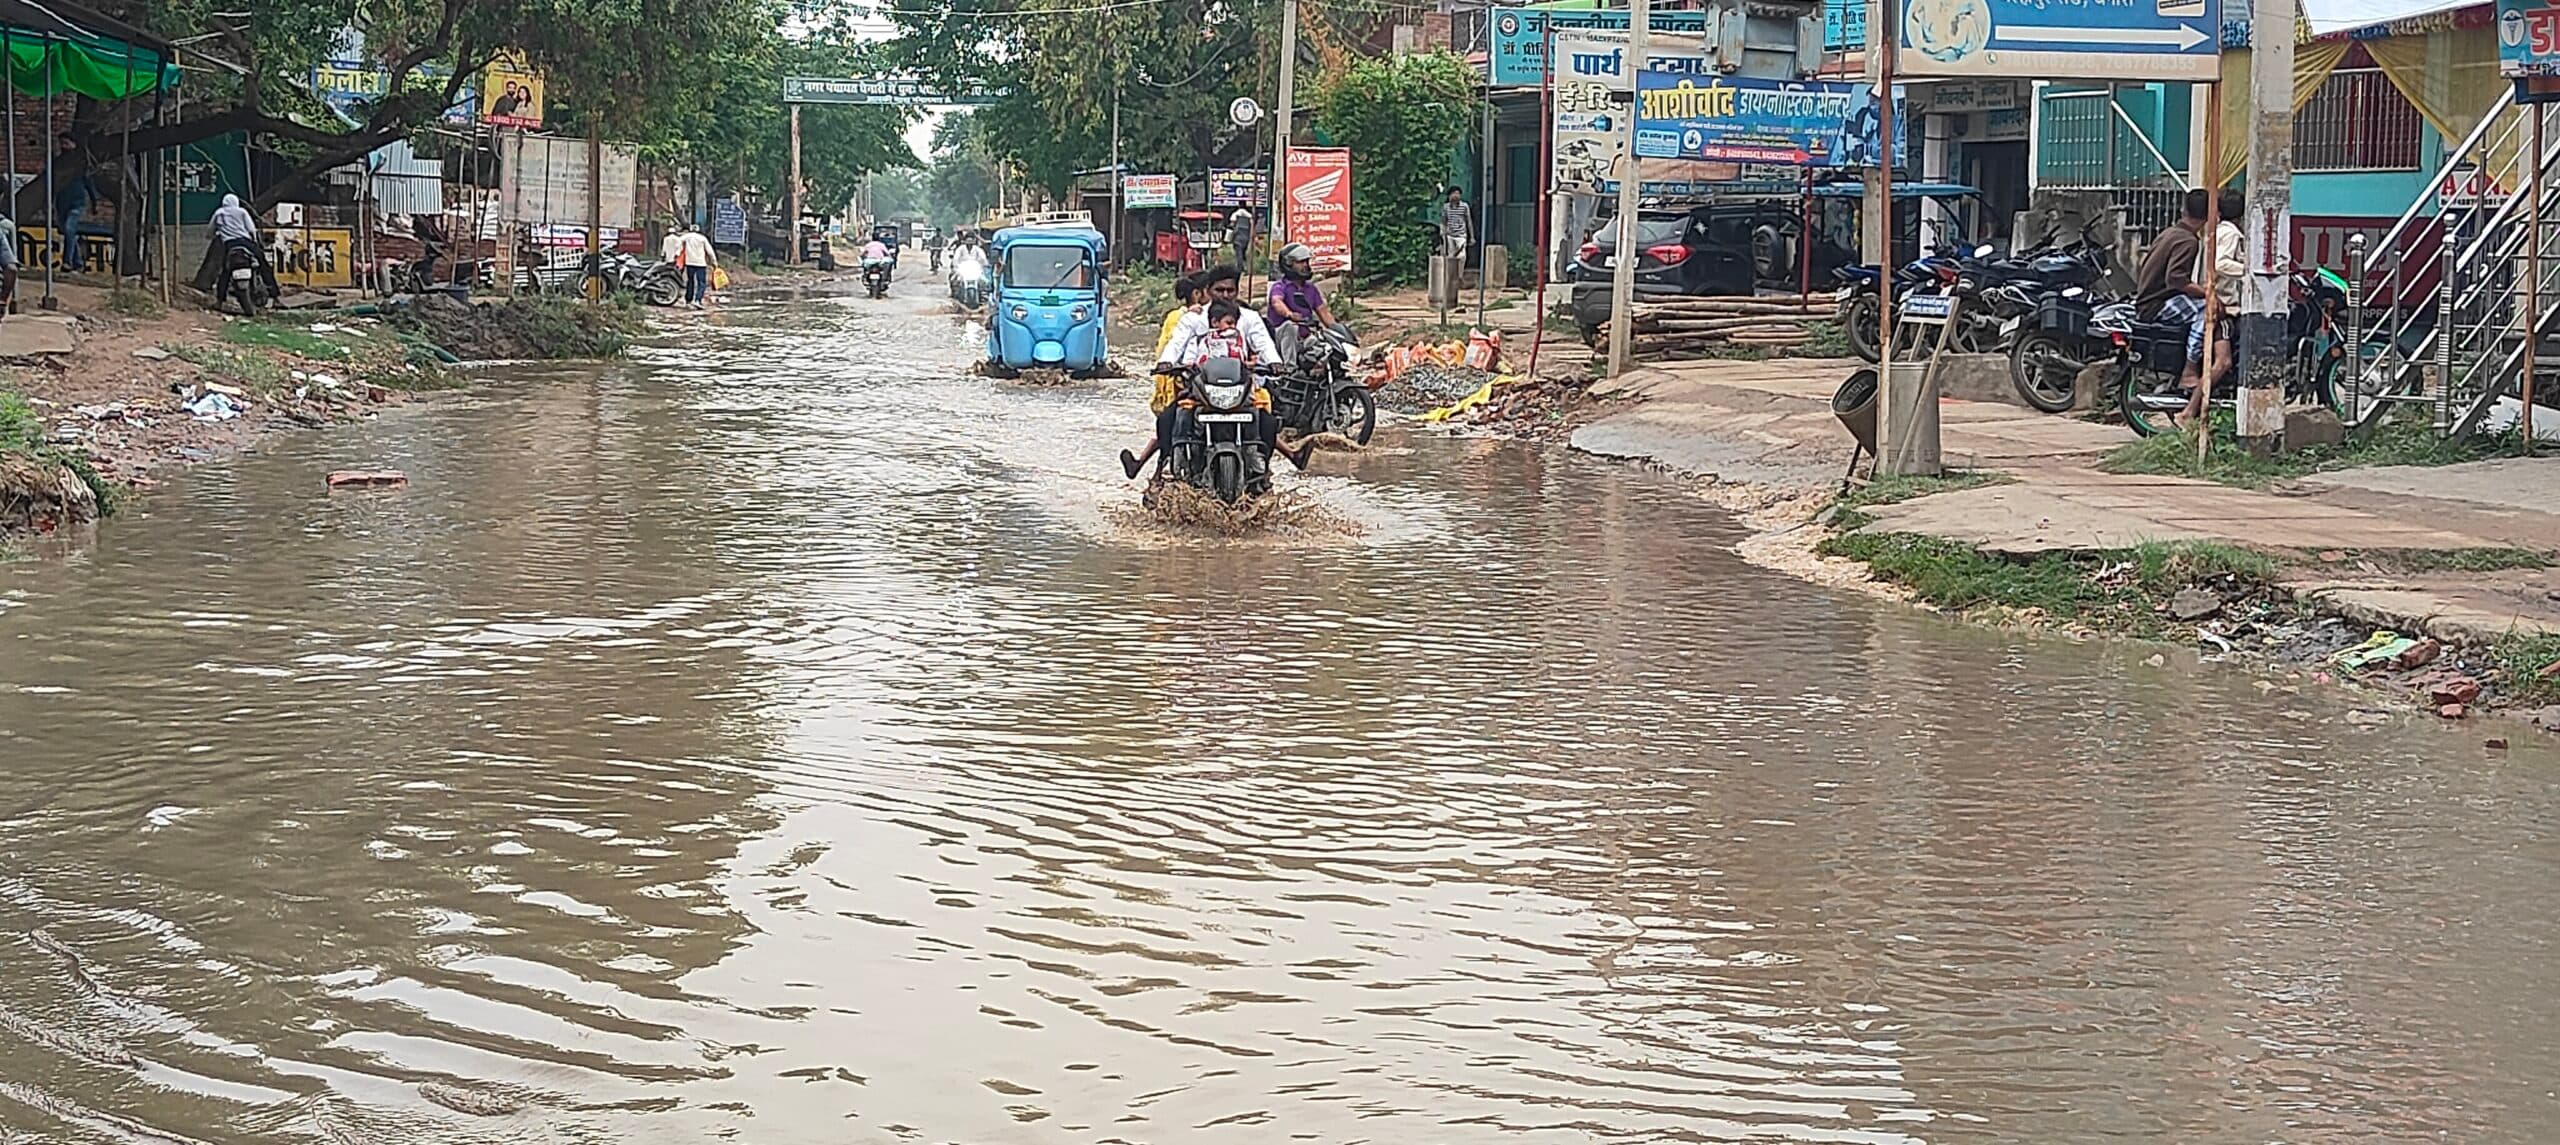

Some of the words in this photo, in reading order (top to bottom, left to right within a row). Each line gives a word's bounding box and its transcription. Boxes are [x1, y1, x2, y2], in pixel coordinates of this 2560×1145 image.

[1572, 48, 1622, 76] पार्थ
[1640, 79, 1737, 121] आशीर्वाद
[1739, 83, 1815, 117] डायग्नोस्टिक
[2441, 174, 2457, 195] A
[1292, 203, 1345, 213] HONDA
